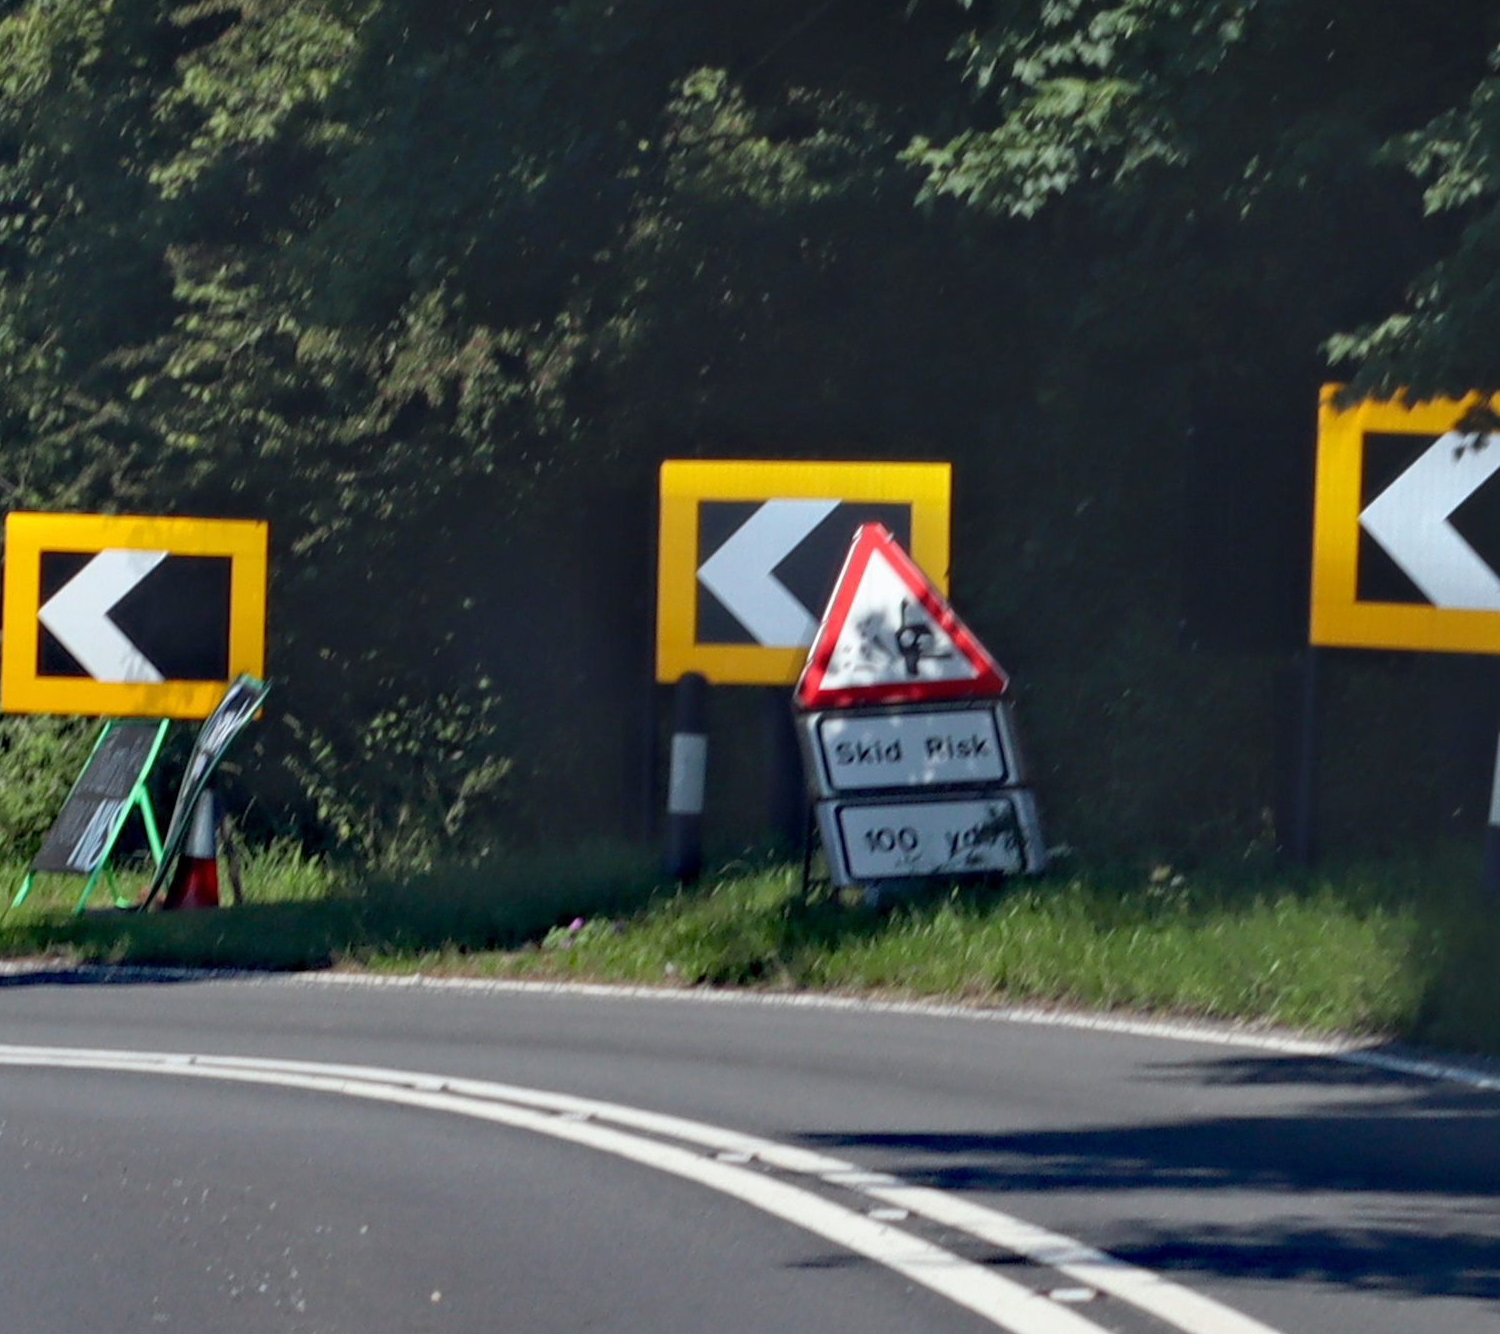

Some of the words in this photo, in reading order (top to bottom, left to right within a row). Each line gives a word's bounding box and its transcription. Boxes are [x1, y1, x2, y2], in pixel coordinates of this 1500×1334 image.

[834, 738, 903, 765] Skid
[925, 734, 990, 760] Risk
[865, 826, 918, 853] 100
